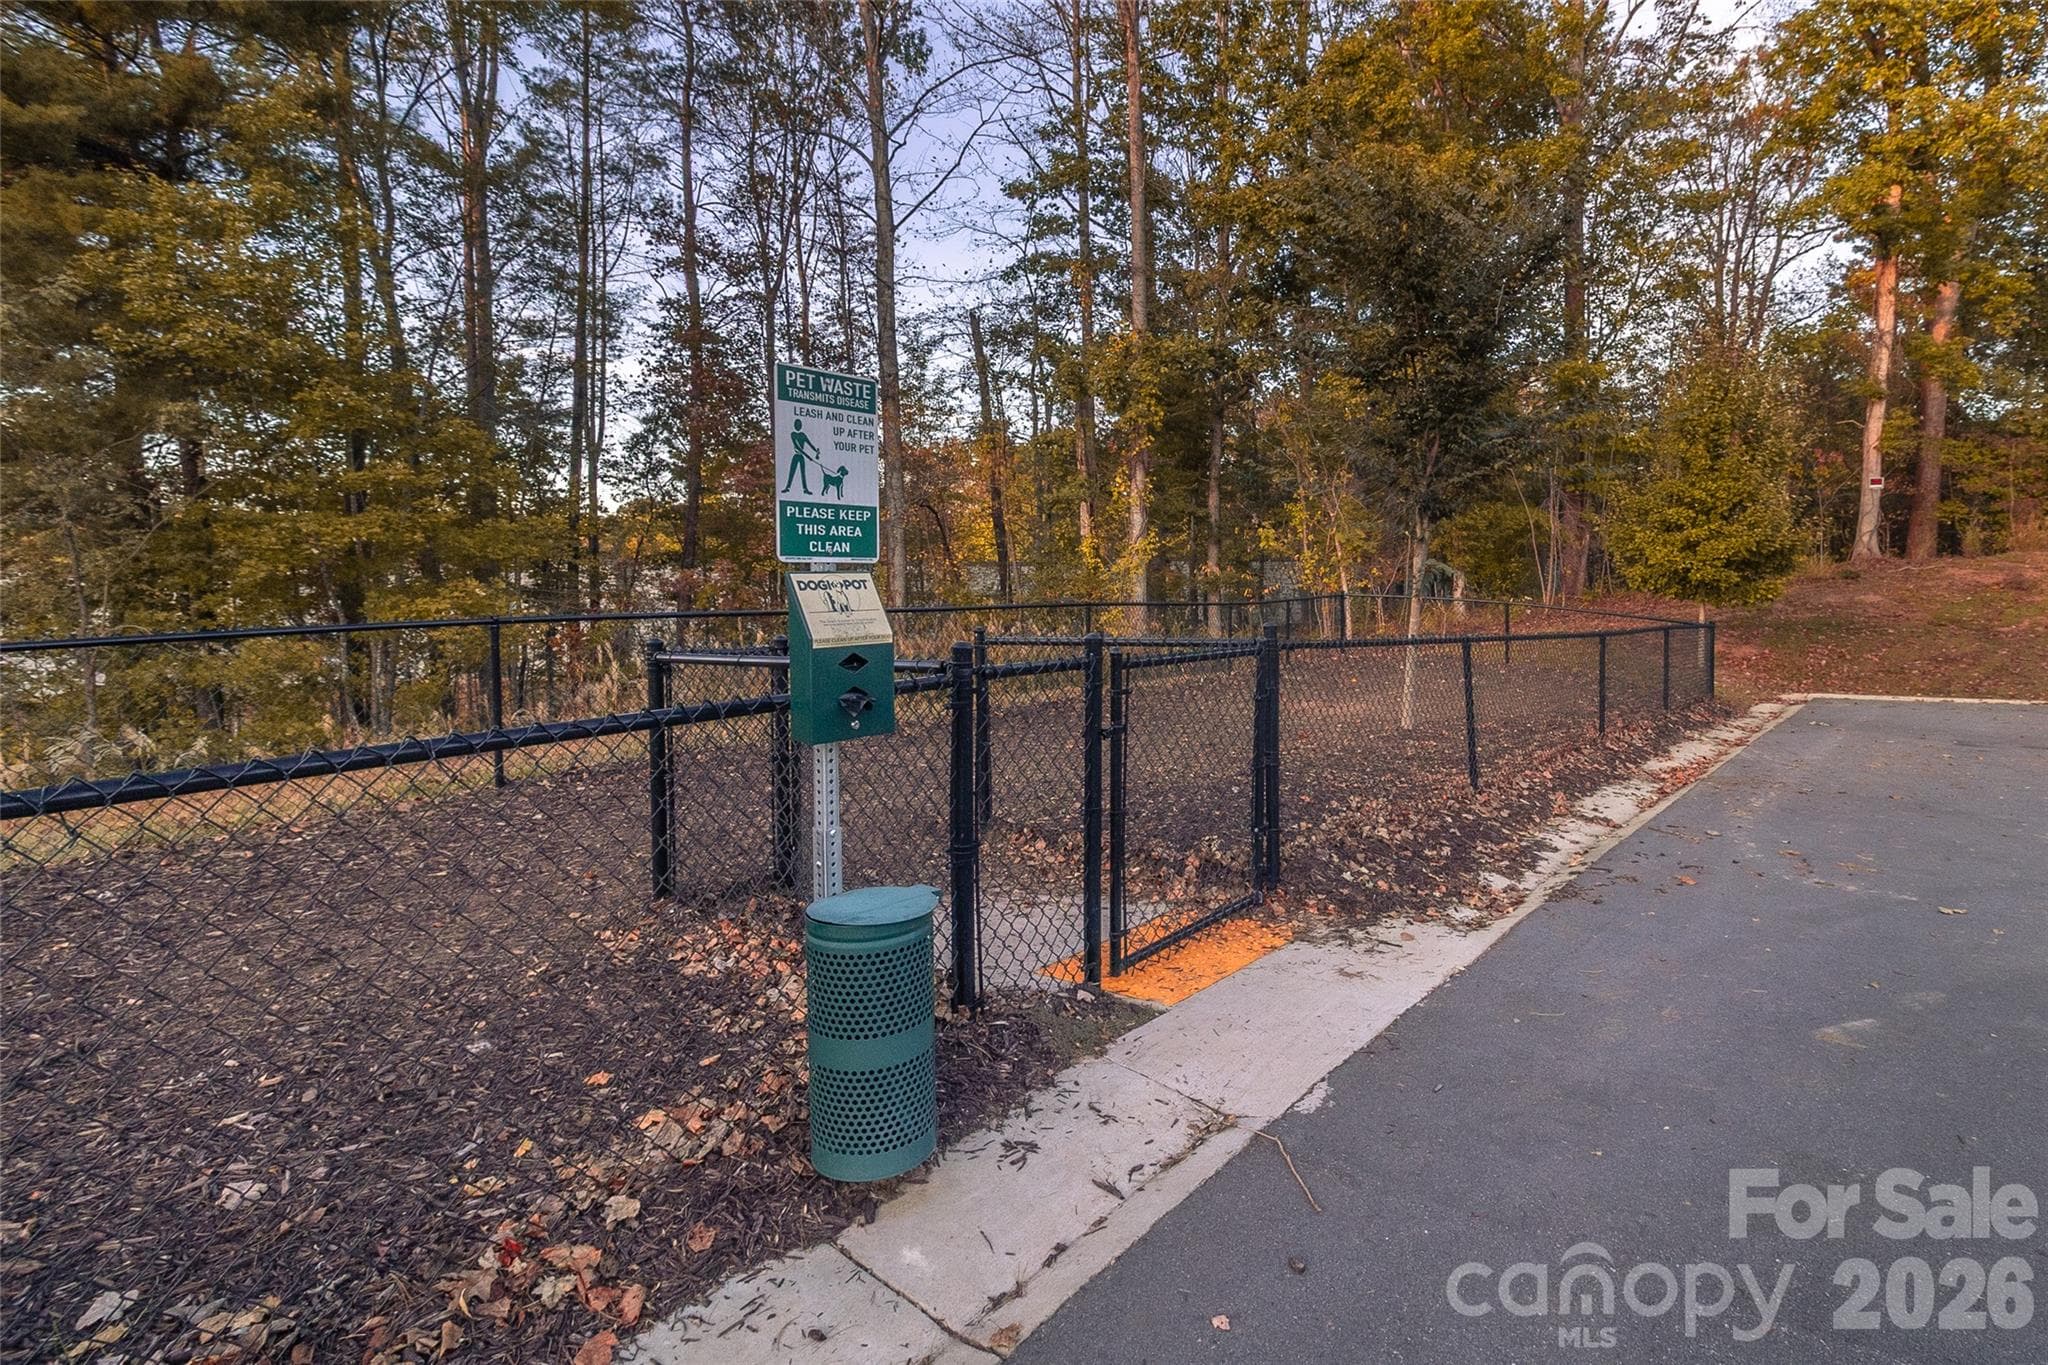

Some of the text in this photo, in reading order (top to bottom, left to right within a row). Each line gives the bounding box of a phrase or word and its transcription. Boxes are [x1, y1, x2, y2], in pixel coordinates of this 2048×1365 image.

[786, 370, 871, 400] PET WASTE
[788, 388, 870, 410] TRANSMITS DISEASE
[794, 406, 874, 426] LEASH AND CLEAN
[832, 426, 874, 440] UP AFTER
[833, 440, 874, 454] YOUR PET
[786, 506, 870, 522] PLEASE KEEP
[796, 524, 862, 537] THIS AREA
[810, 541, 850, 552] CLEAN
